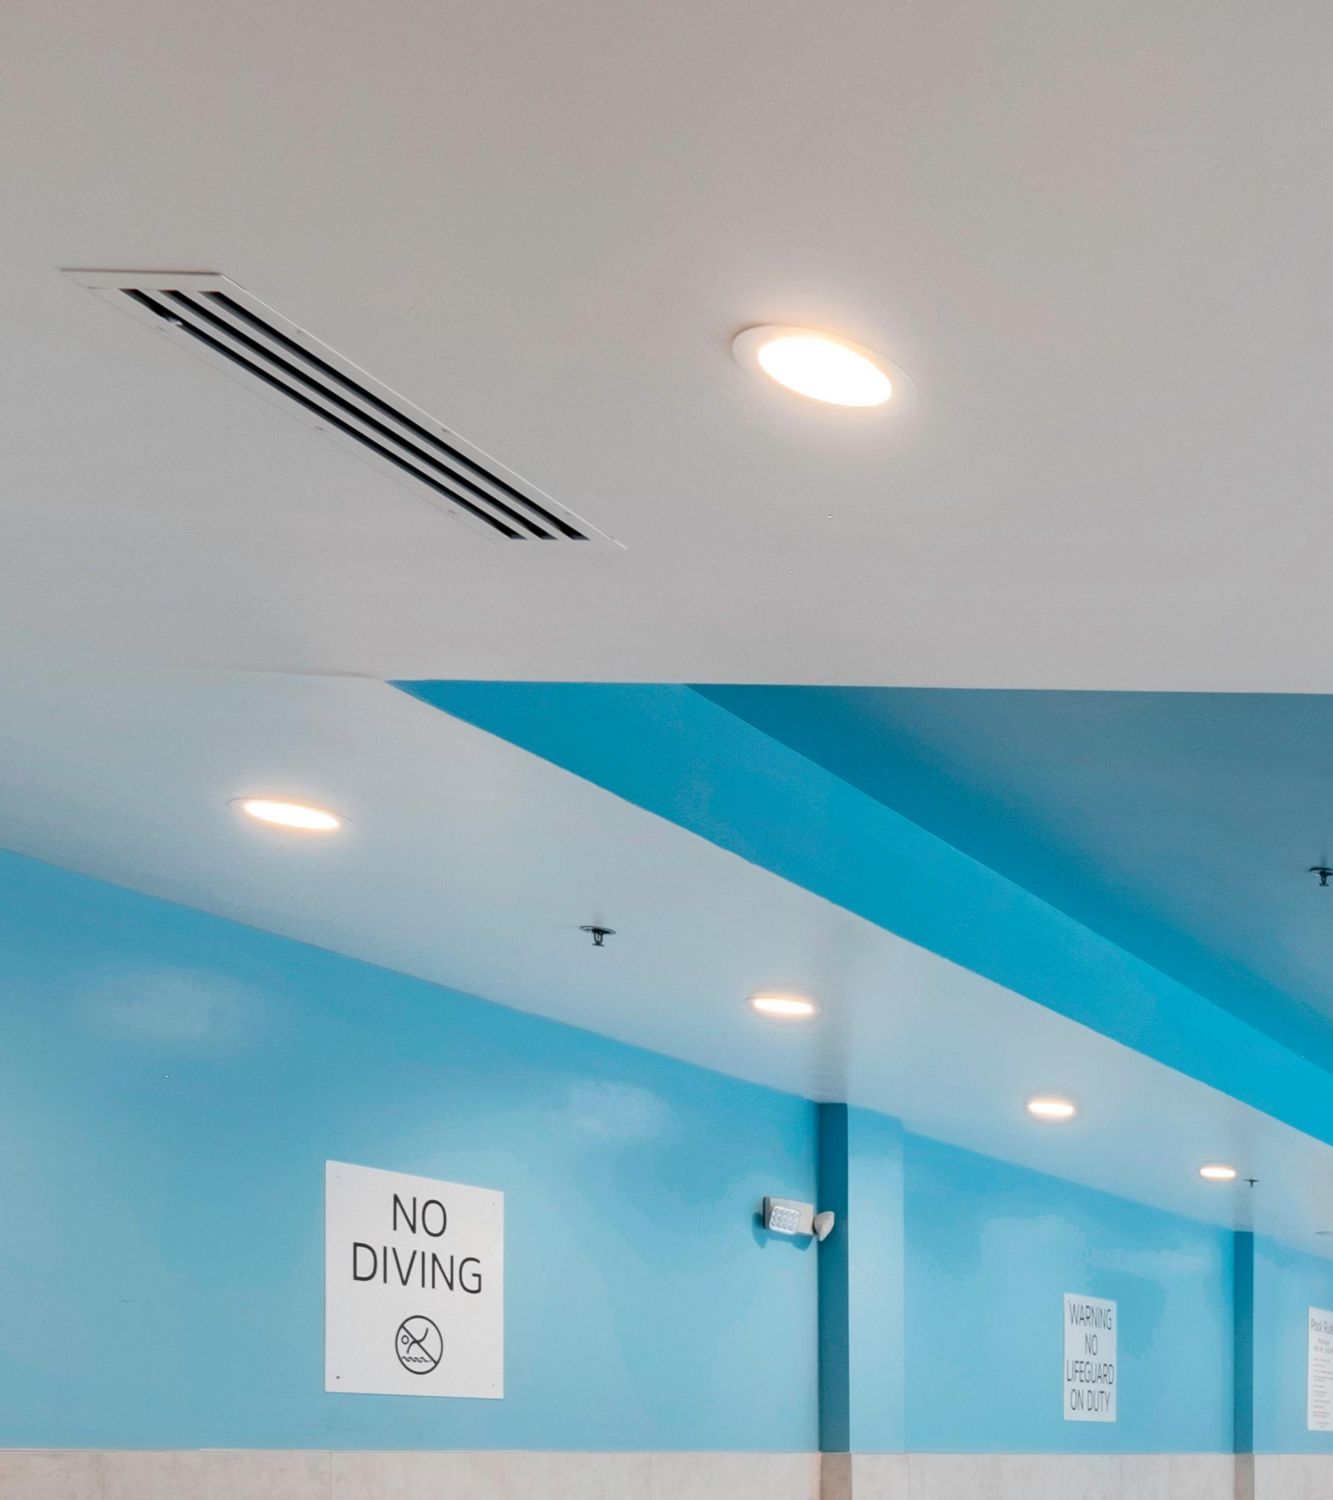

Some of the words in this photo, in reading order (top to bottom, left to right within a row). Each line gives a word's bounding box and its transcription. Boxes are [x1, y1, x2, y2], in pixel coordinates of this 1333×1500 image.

[393, 1193, 447, 1237] NO
[353, 1242, 482, 1294] DIVING
[1068, 1301, 1112, 1330] WARNING
[1085, 1334, 1098, 1356] NO
[1066, 1359, 1114, 1385] LIFEGUARD
[1070, 1389, 1084, 1411] ON
[1088, 1390, 1111, 1412] DUTY
